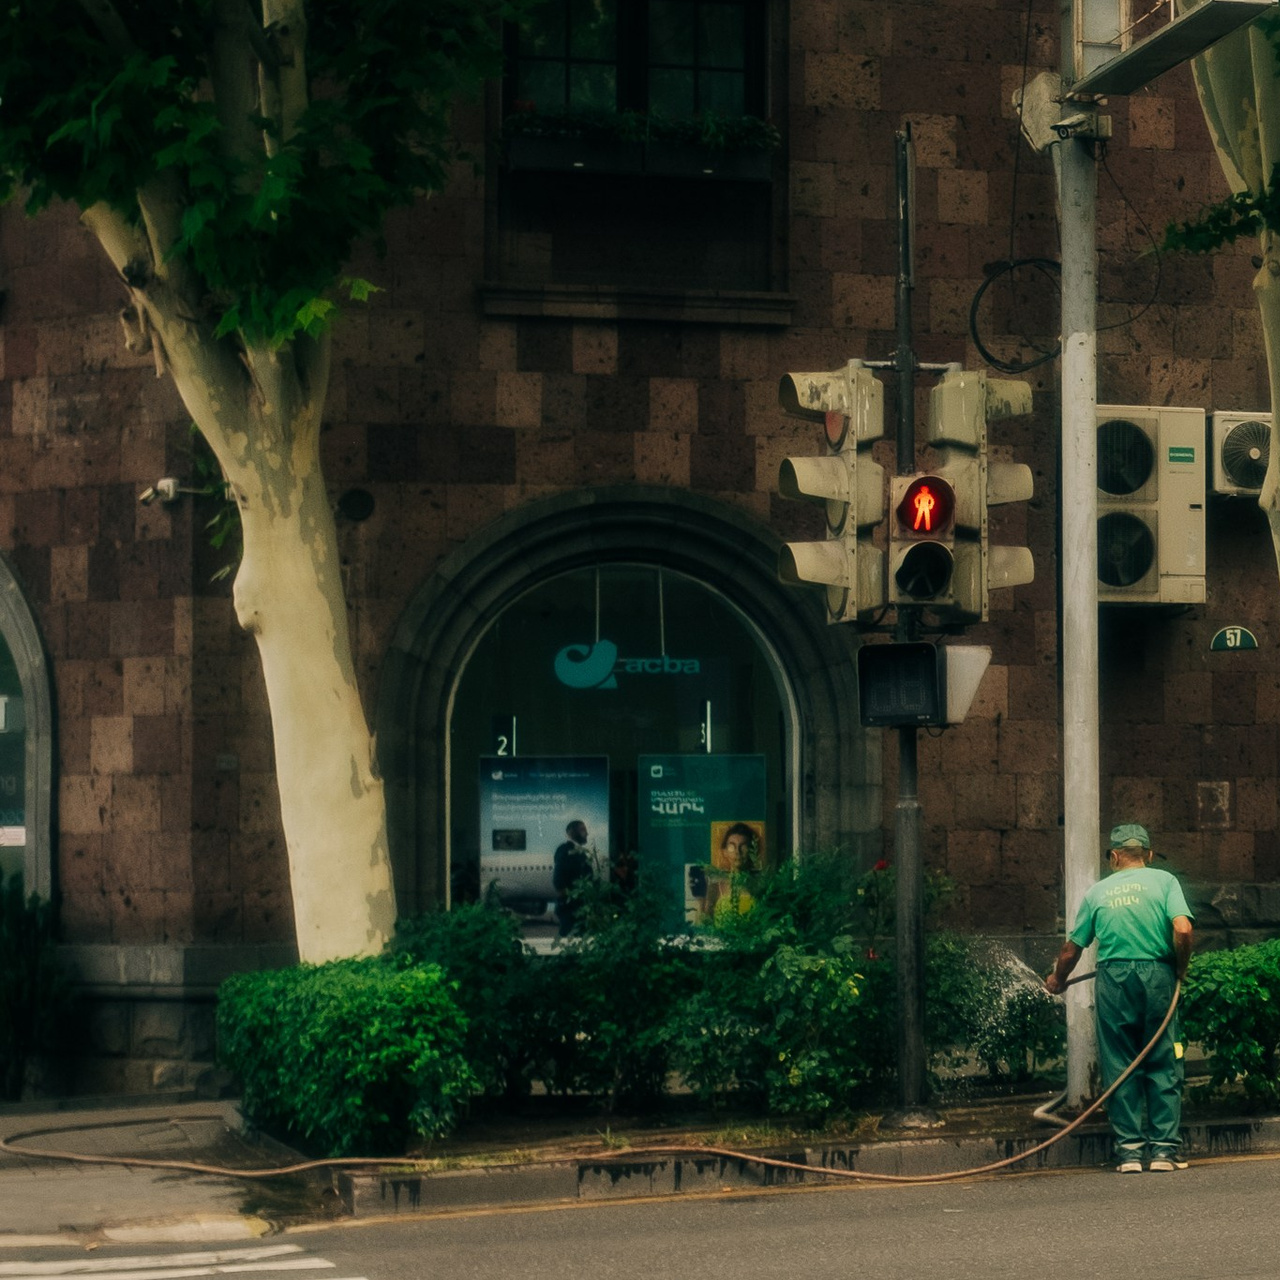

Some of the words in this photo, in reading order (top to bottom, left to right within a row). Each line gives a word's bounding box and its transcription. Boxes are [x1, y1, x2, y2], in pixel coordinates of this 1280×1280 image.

[1226, 629, 1241, 647] 57
[625, 655, 700, 674] acba
[497, 735, 508, 756] 2
[651, 802, 705, 815] ՎԱՐԿ
